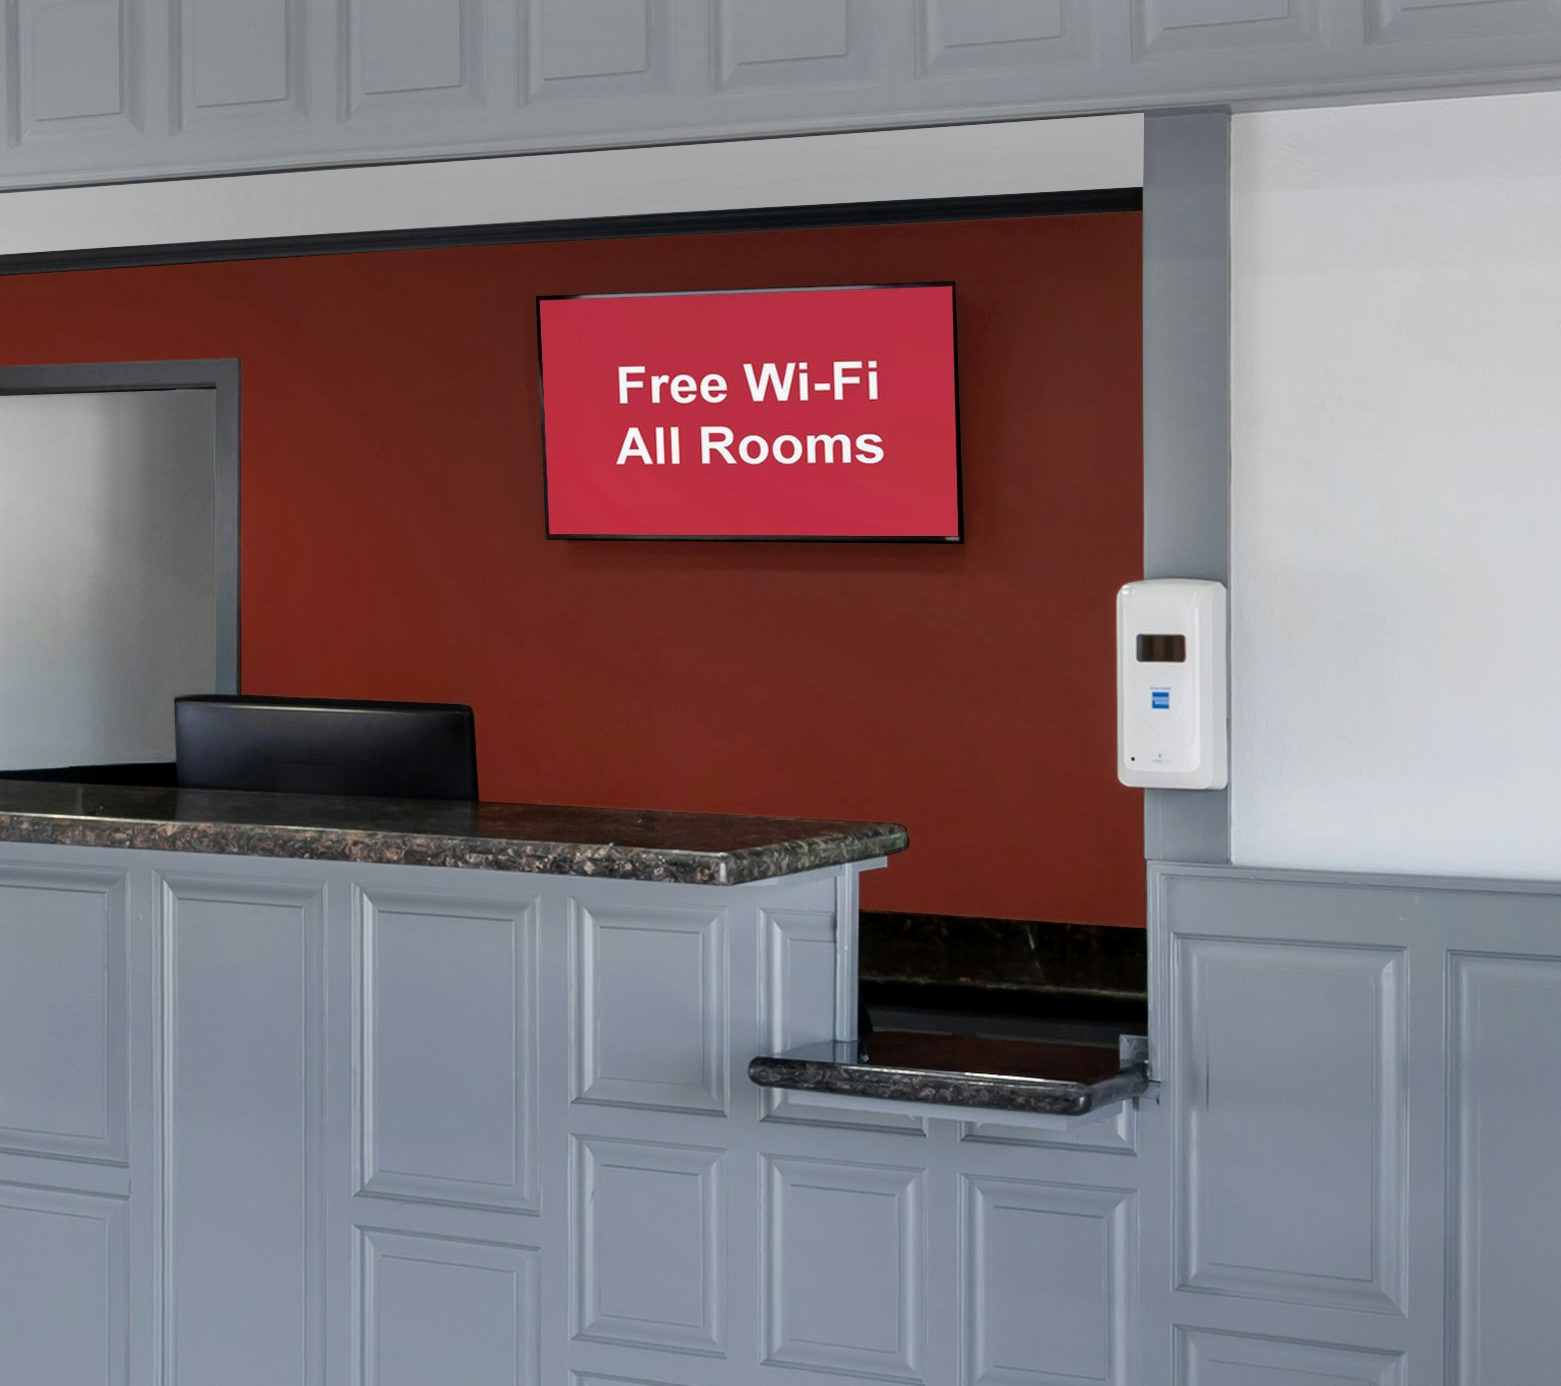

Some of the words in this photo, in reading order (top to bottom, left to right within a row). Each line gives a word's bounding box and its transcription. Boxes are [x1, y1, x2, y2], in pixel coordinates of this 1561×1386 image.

[618, 366, 728, 404] Free
[743, 361, 879, 402] Wi-Fi
[616, 426, 680, 465] All
[700, 426, 885, 465] Rooms
